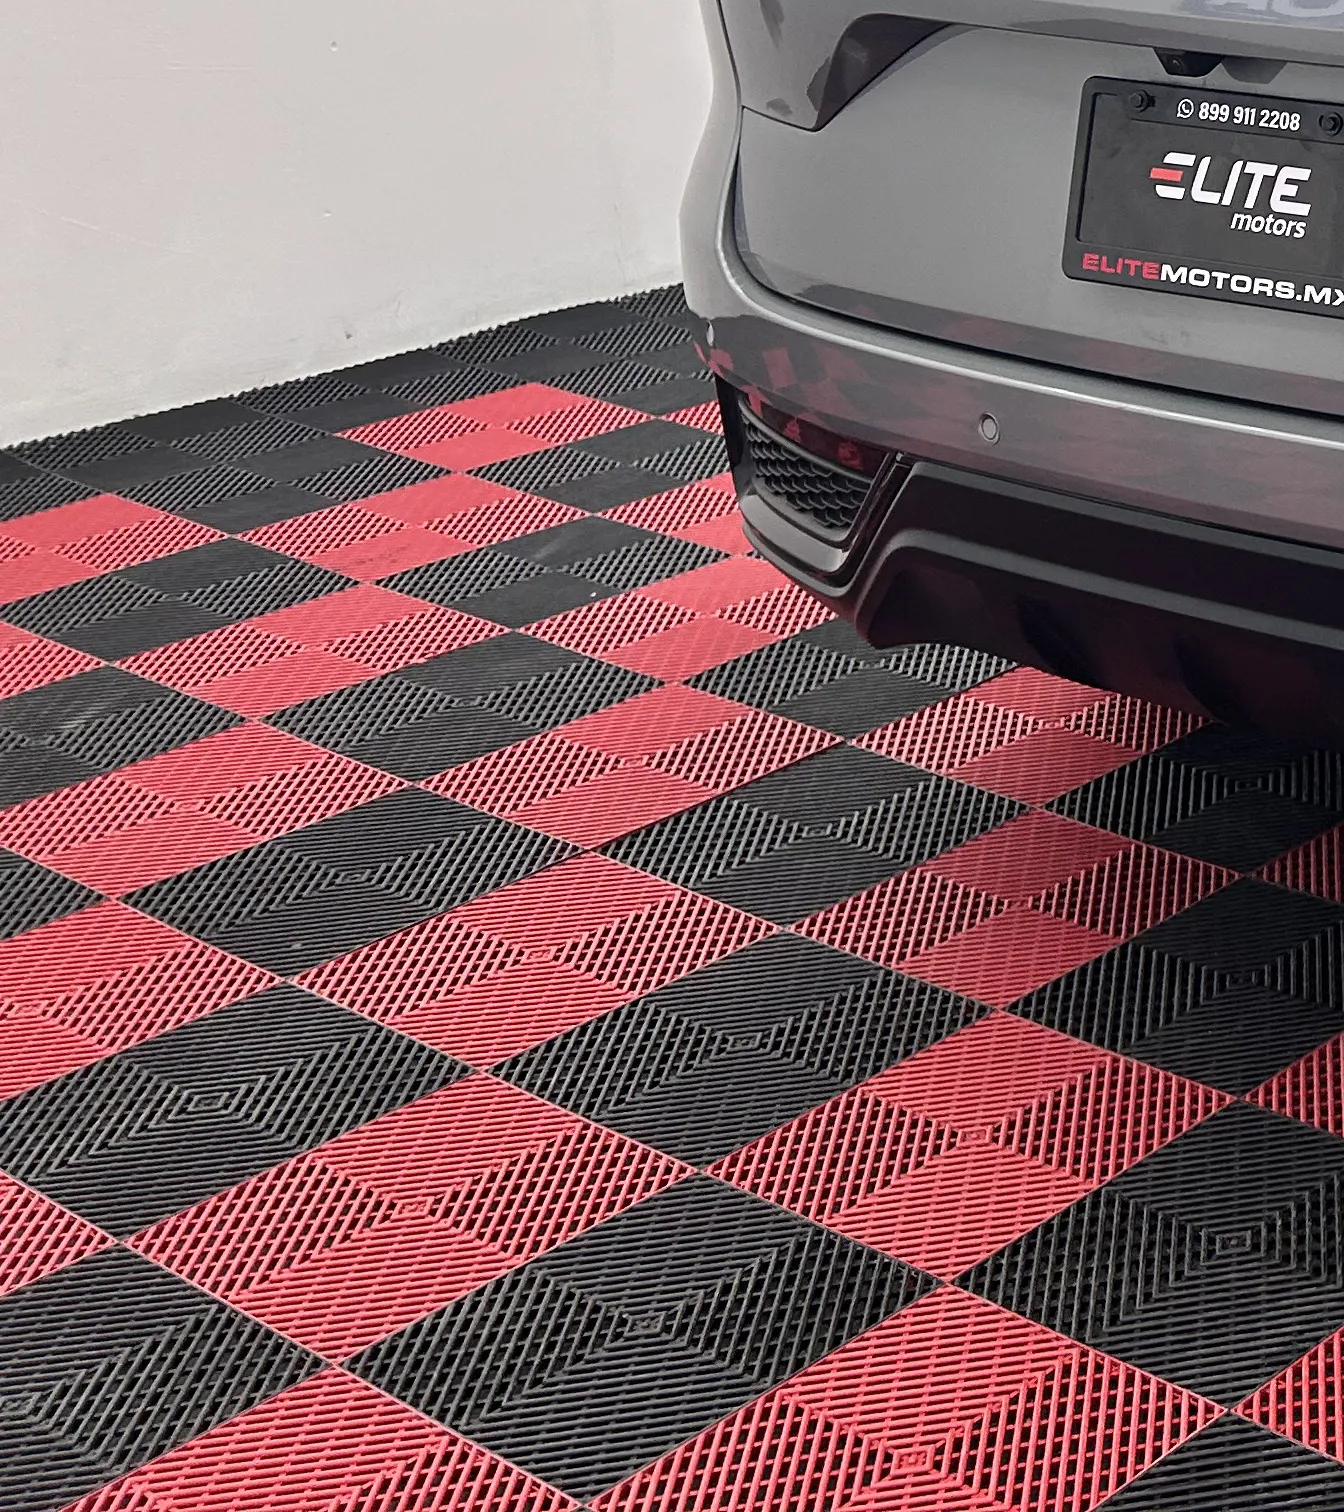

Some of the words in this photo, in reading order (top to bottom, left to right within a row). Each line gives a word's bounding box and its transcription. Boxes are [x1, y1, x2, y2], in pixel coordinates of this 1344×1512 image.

[1198, 101, 1230, 123] 899
[1232, 105, 1256, 126] 911
[1258, 109, 1302, 131] 2208
[1149, 151, 1313, 217] ELITE
[1230, 211, 1307, 239] motors
